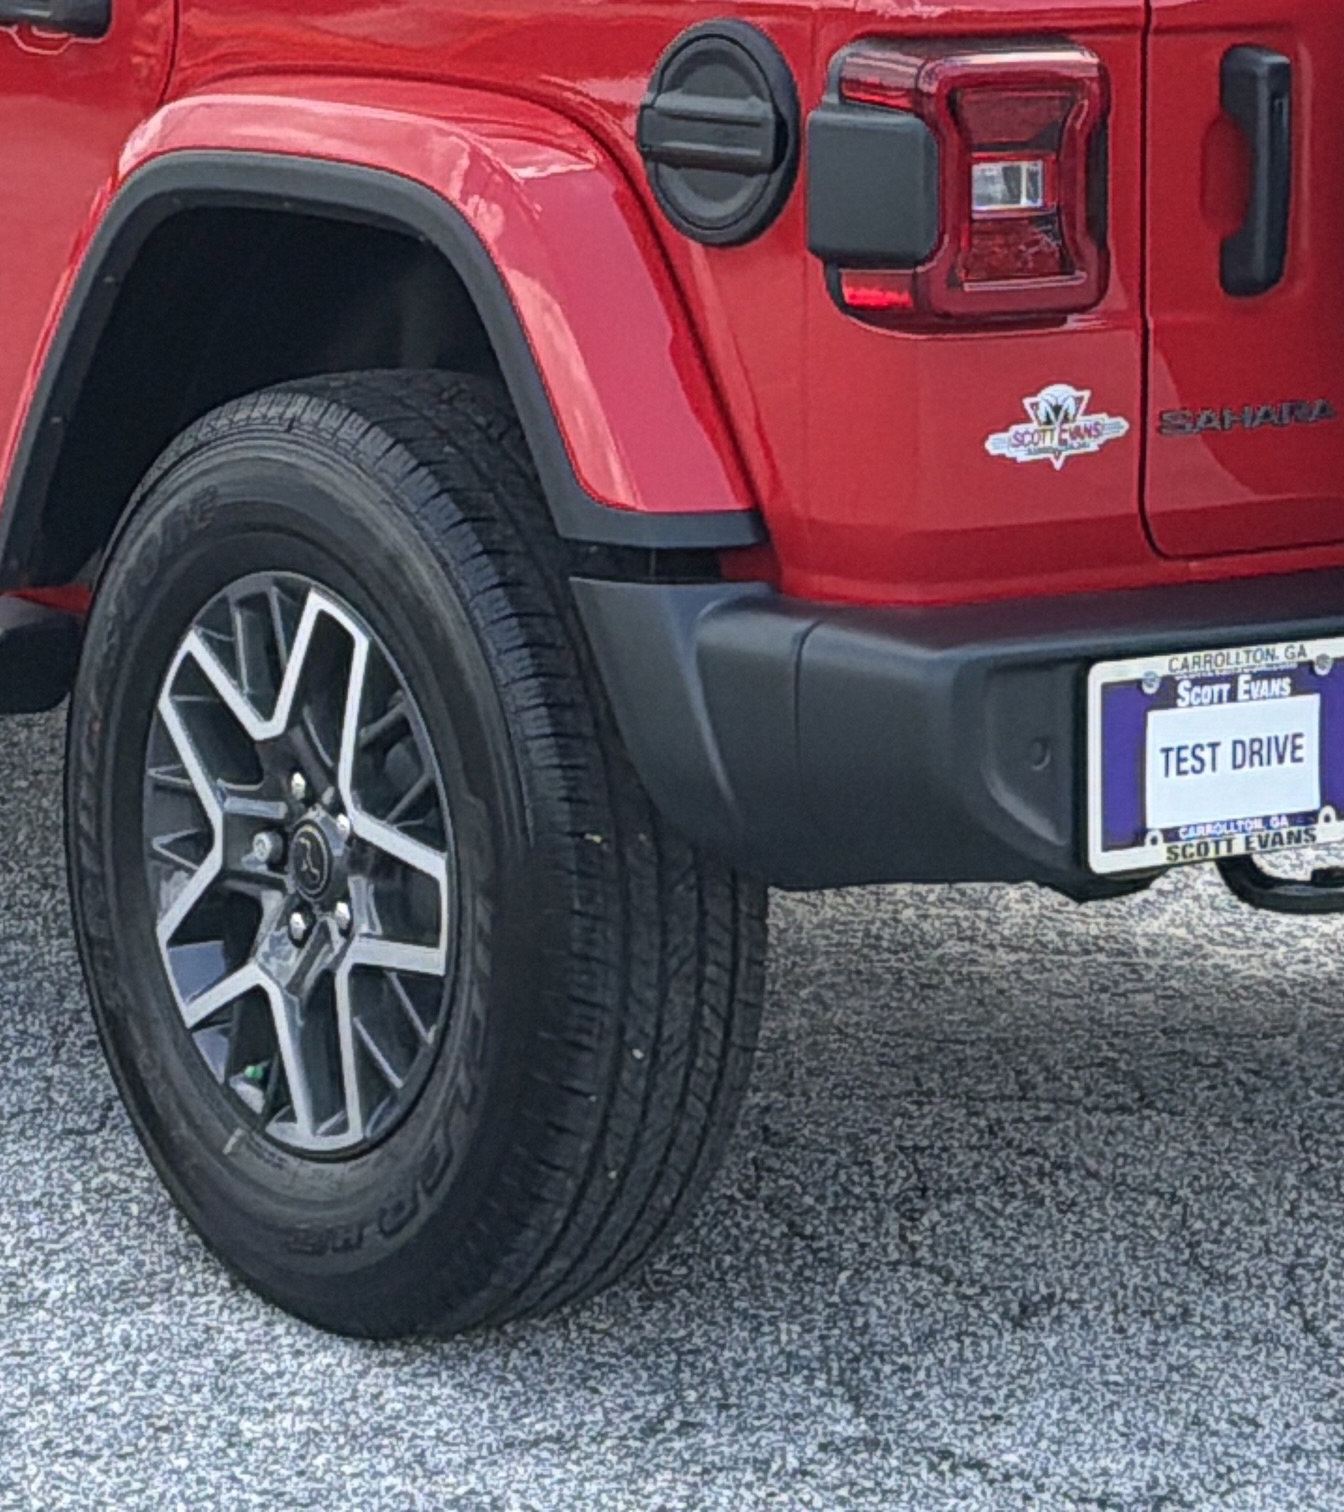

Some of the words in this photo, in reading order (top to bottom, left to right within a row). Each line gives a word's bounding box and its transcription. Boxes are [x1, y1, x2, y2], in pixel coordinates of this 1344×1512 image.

[1011, 427, 1056, 448] SCOTT
[1057, 420, 1104, 446] EVANS
[1159, 398, 1337, 437] SAHARA
[1284, 644, 1308, 660] GA
[1159, 741, 1221, 779] TEST
[1232, 732, 1305, 767] DRIVE
[1165, 836, 1234, 862] SCOTT
[1244, 827, 1318, 851] EVANS
